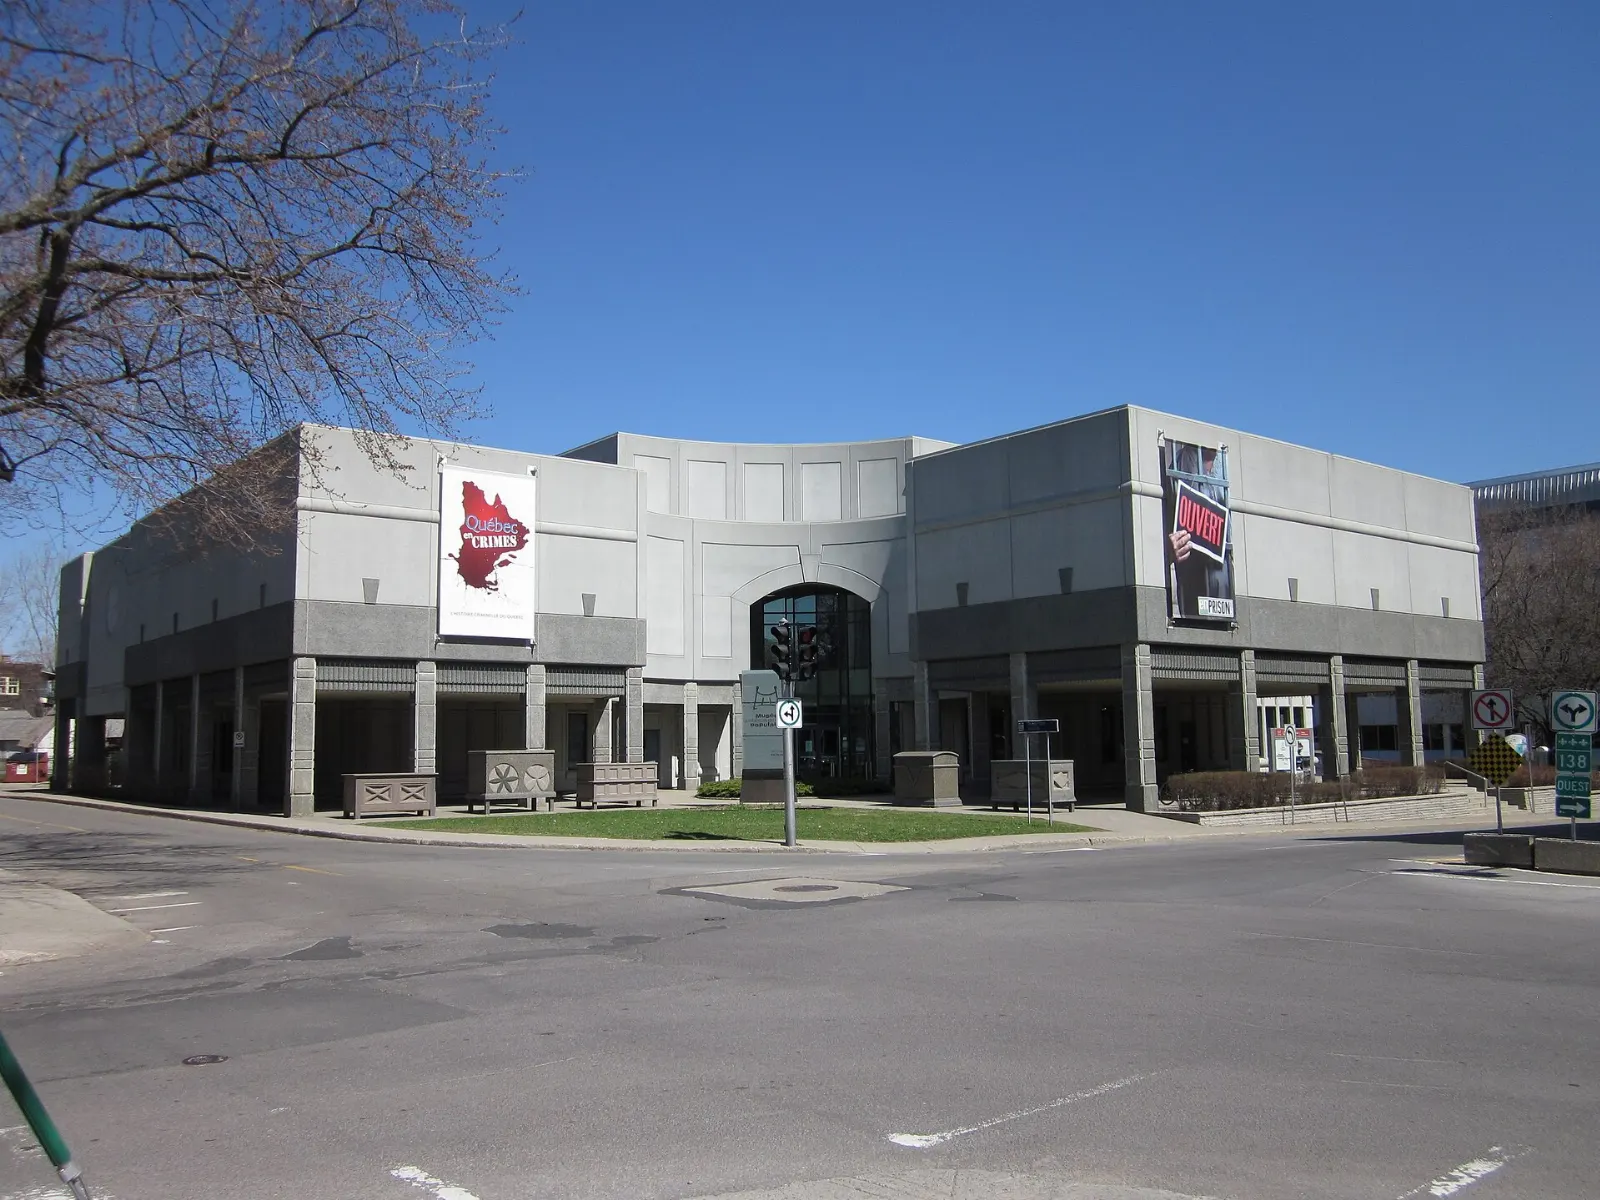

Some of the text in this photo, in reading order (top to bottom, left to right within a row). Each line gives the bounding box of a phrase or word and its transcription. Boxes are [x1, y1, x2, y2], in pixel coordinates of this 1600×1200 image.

[465, 514, 519, 535] Québec
[1179, 495, 1225, 546] OUVERT
[463, 532, 518, 549] en CRIMES
[1208, 600, 1231, 615] PRISON
[1559, 754, 1587, 769] 138
[1557, 780, 1590, 792] OUEST
